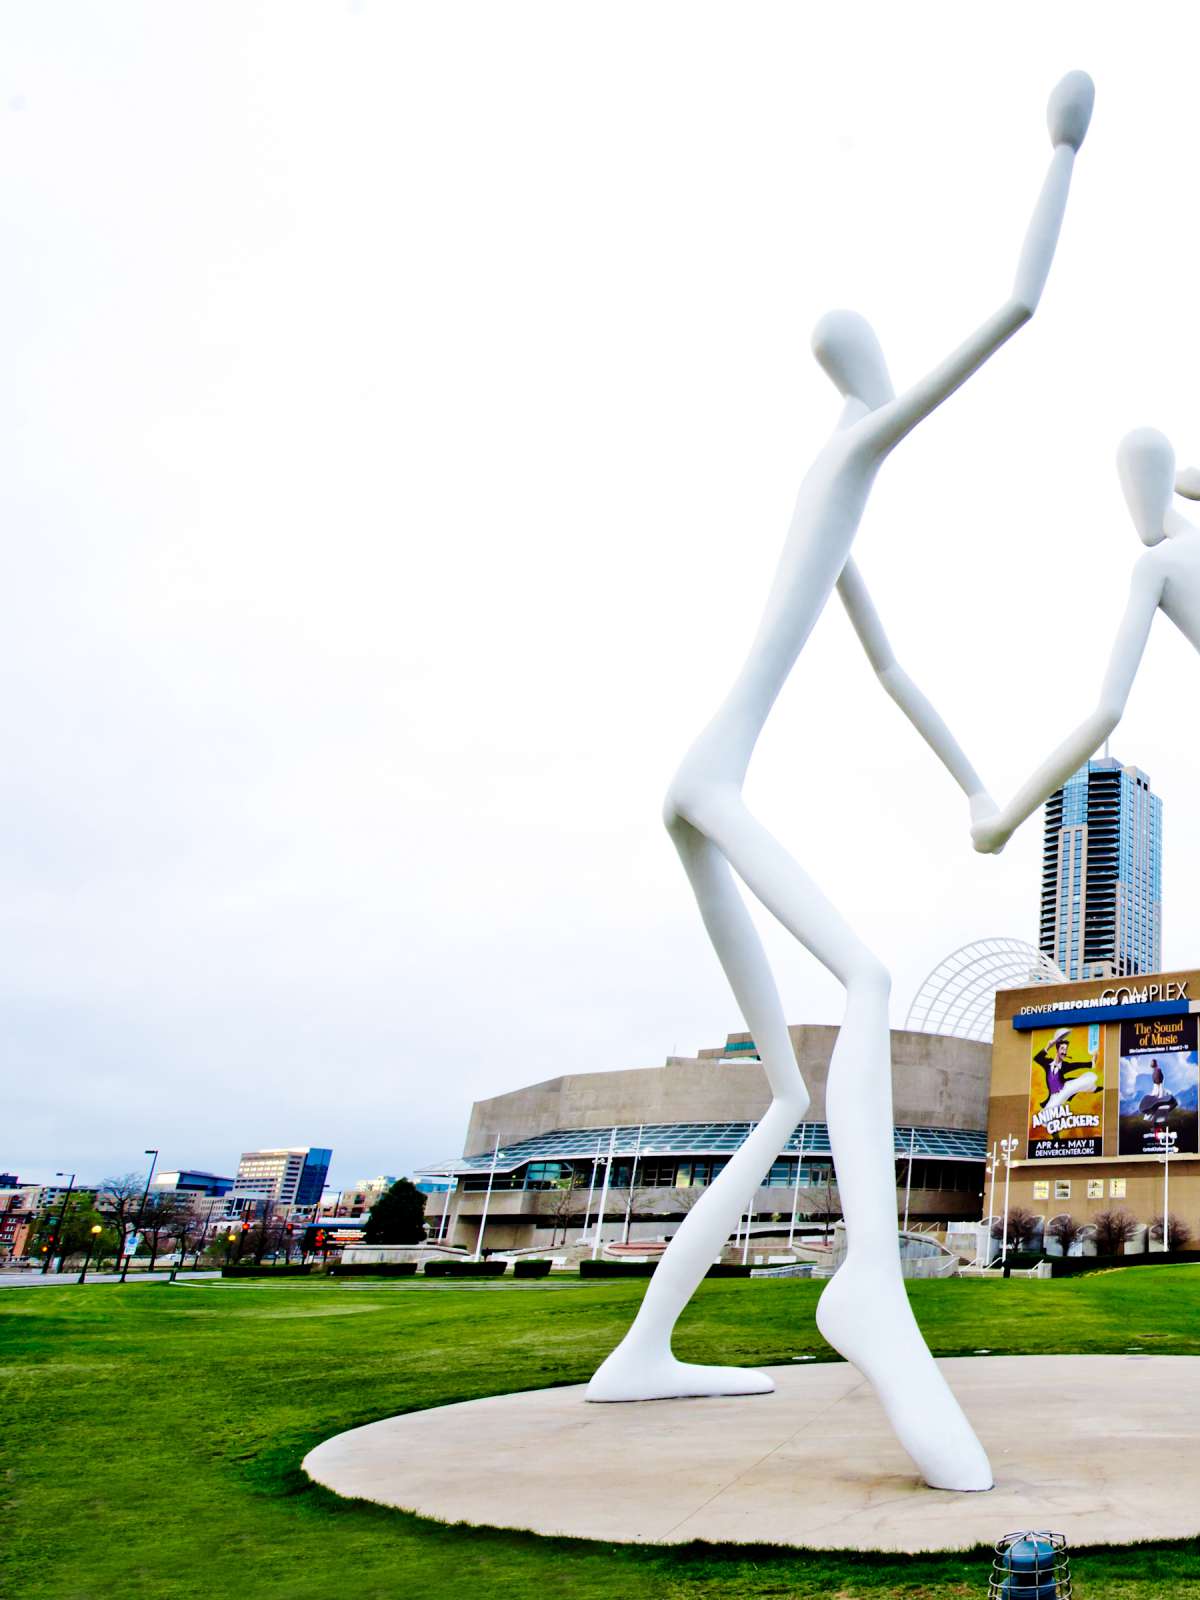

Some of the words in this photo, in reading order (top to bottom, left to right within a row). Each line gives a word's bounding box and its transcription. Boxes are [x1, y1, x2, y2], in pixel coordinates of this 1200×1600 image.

[1101, 981, 1189, 1005] COMPLEX
[1052, 997, 1118, 1011] PERFORMING
[1121, 994, 1147, 1006] ARTS
[1135, 1022, 1151, 1035] The
[1154, 1019, 1184, 1034] Sound
[1139, 1034, 1150, 1046] of
[1151, 1033, 1178, 1046] Music
[1032, 1104, 1073, 1128] ANIMAL
[1047, 1115, 1100, 1135] CRACKERS
[1036, 1141, 1051, 1149] APR
[1068, 1140, 1086, 1148] MAY
[1089, 1139, 1095, 1147] 11
[1035, 1148, 1095, 1157] DENVERCENTER.ORG
